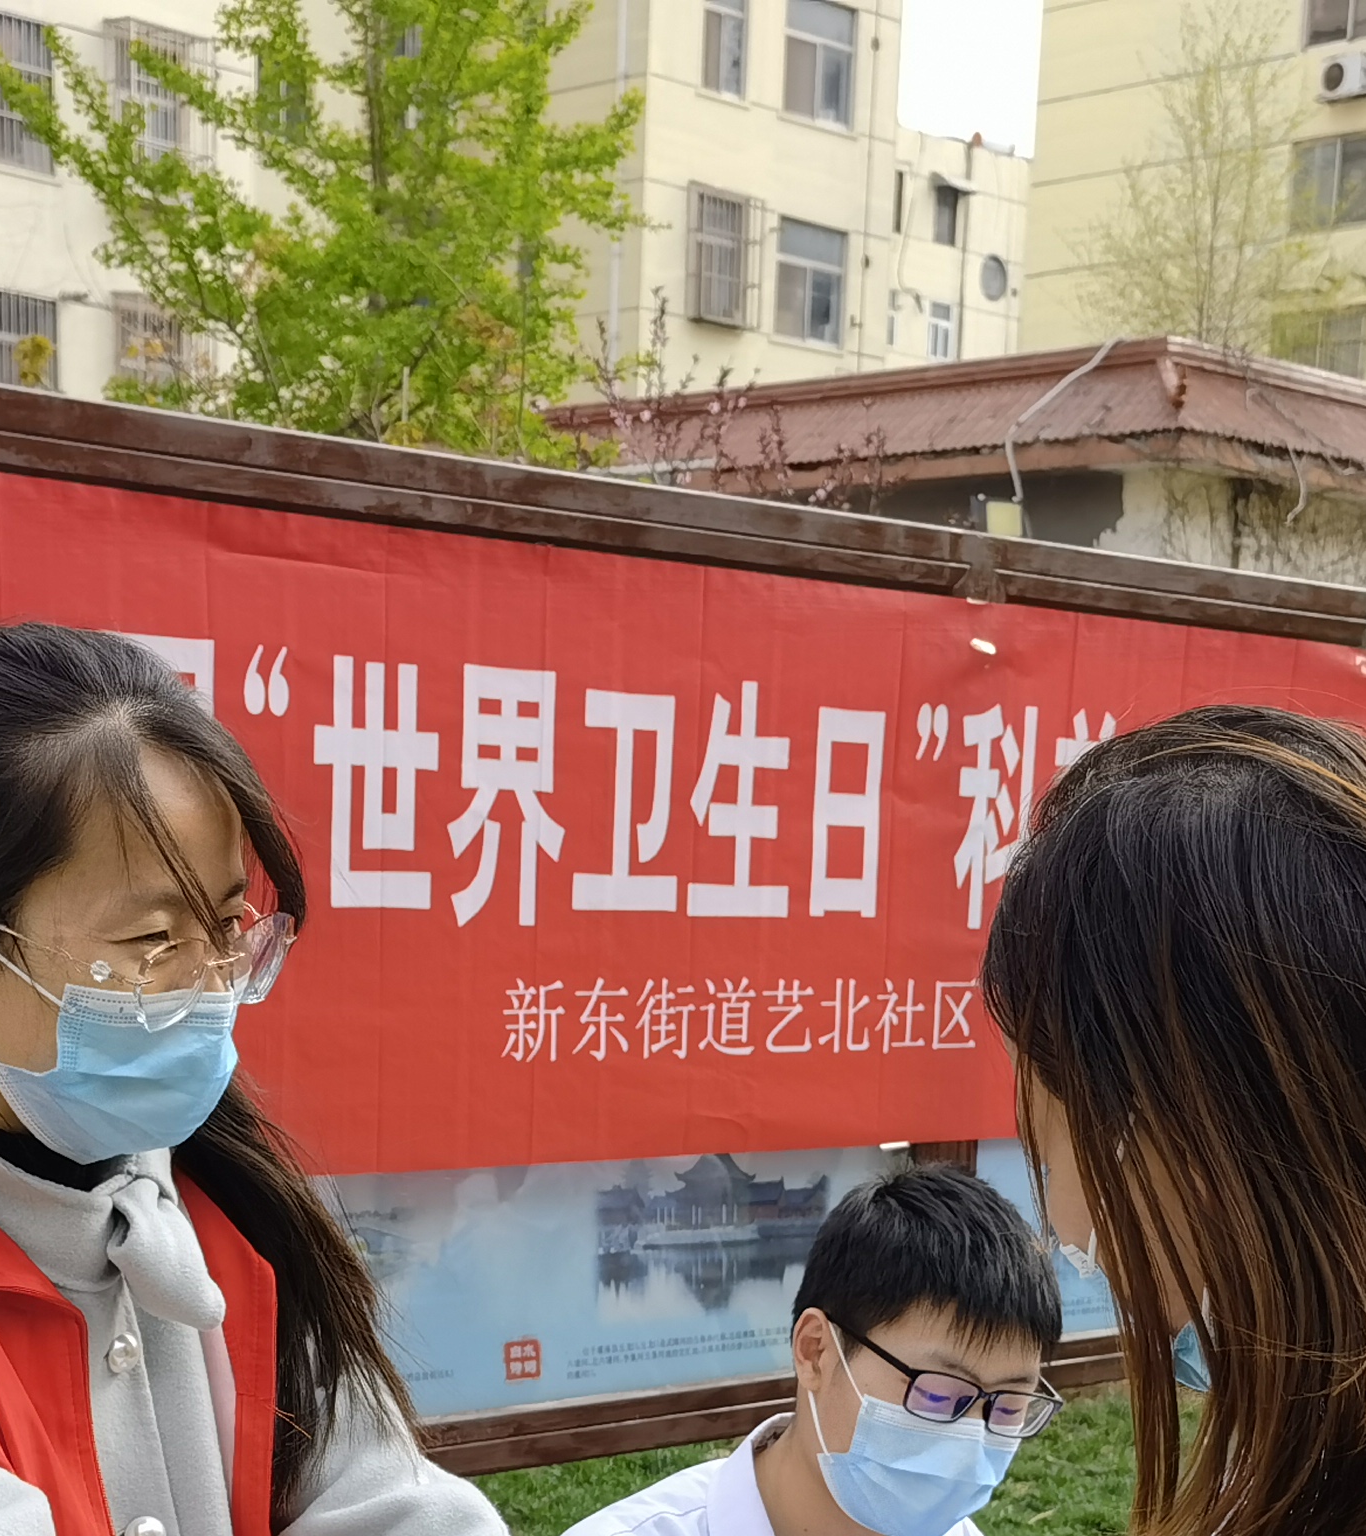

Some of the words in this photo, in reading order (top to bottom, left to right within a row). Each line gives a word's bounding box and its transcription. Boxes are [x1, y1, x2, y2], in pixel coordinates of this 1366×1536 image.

[501, 975, 978, 1062] 新东街道艺北社区
